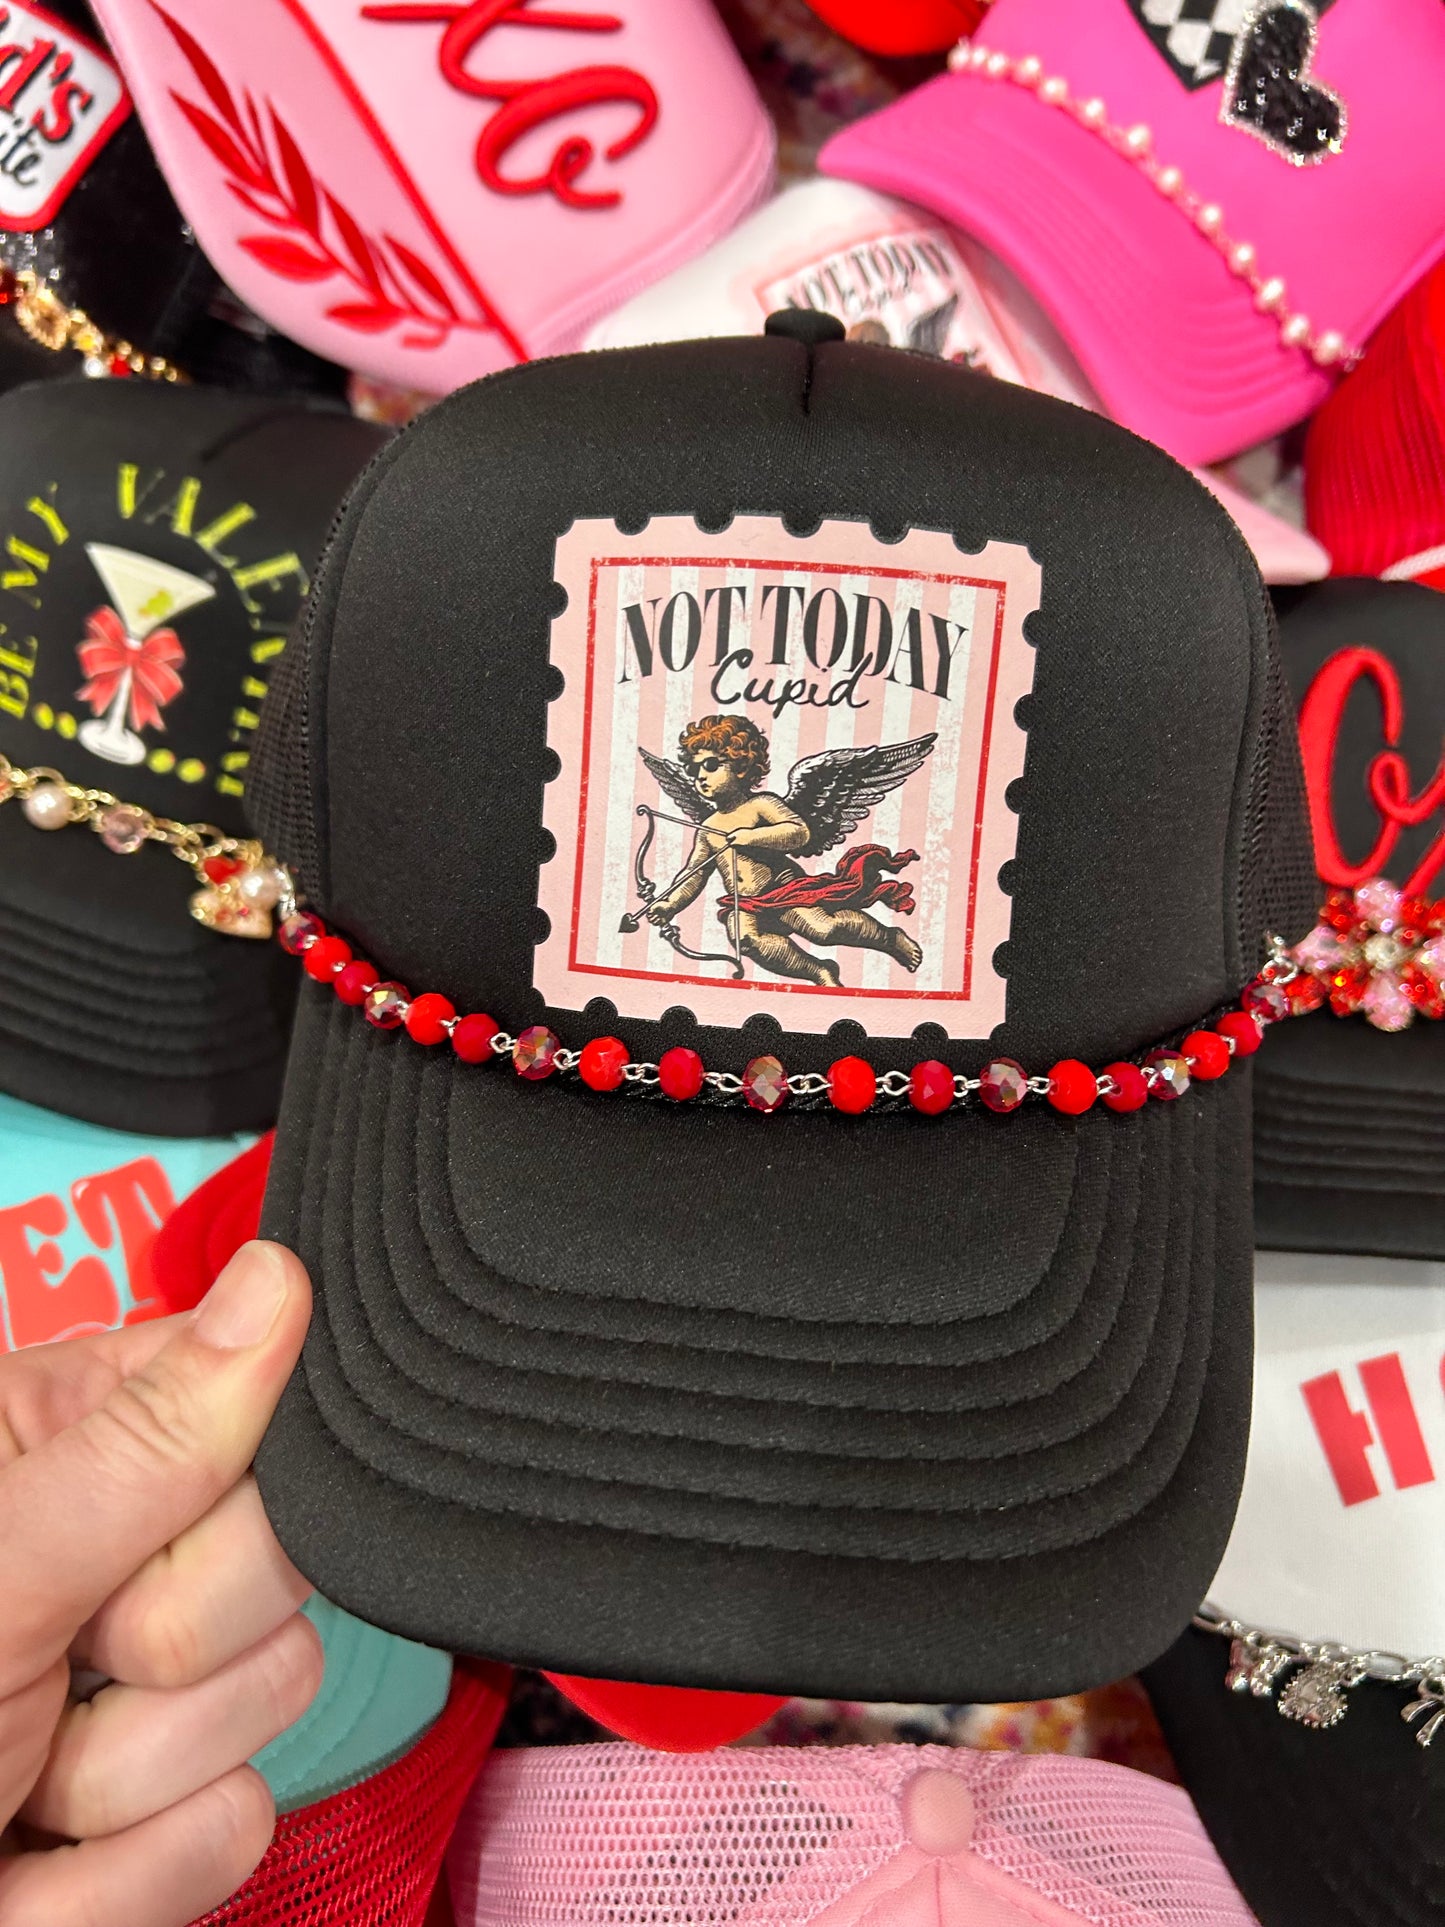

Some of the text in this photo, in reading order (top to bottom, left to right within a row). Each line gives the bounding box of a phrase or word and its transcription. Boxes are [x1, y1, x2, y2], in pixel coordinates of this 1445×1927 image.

[0, 5, 94, 143] d's
[1, 481, 70, 609] MY
[0, 622, 38, 719] BE
[617, 585, 970, 701] NOT TODAY
[710, 647, 870, 719] Cupid
[0, 1155, 177, 1353] ET
[1299, 1352, 1445, 1508] H
